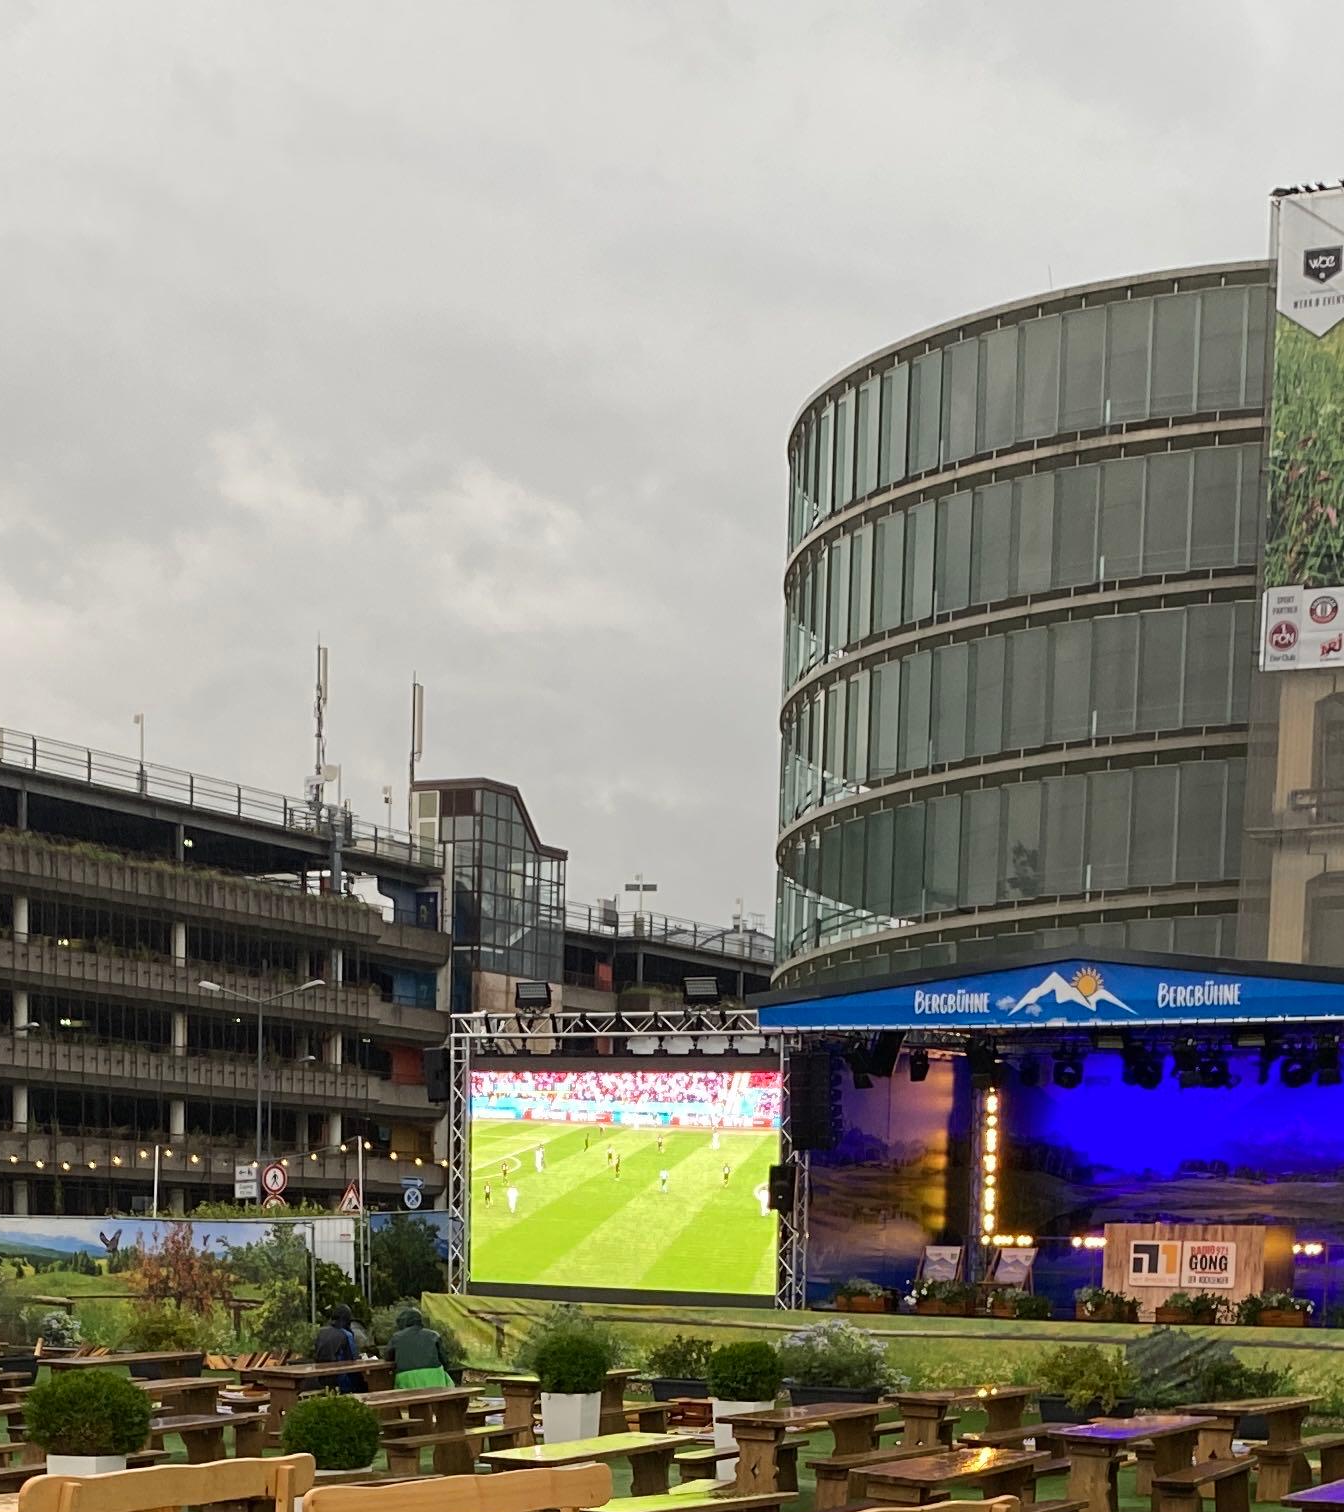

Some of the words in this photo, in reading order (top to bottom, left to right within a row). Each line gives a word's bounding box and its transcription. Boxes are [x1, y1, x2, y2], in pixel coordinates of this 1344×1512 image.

[914, 989, 990, 1015] BERGBÜHNE
[1157, 980, 1242, 1009] BERGBÜHNE
[1188, 1255, 1229, 1272] GONG
